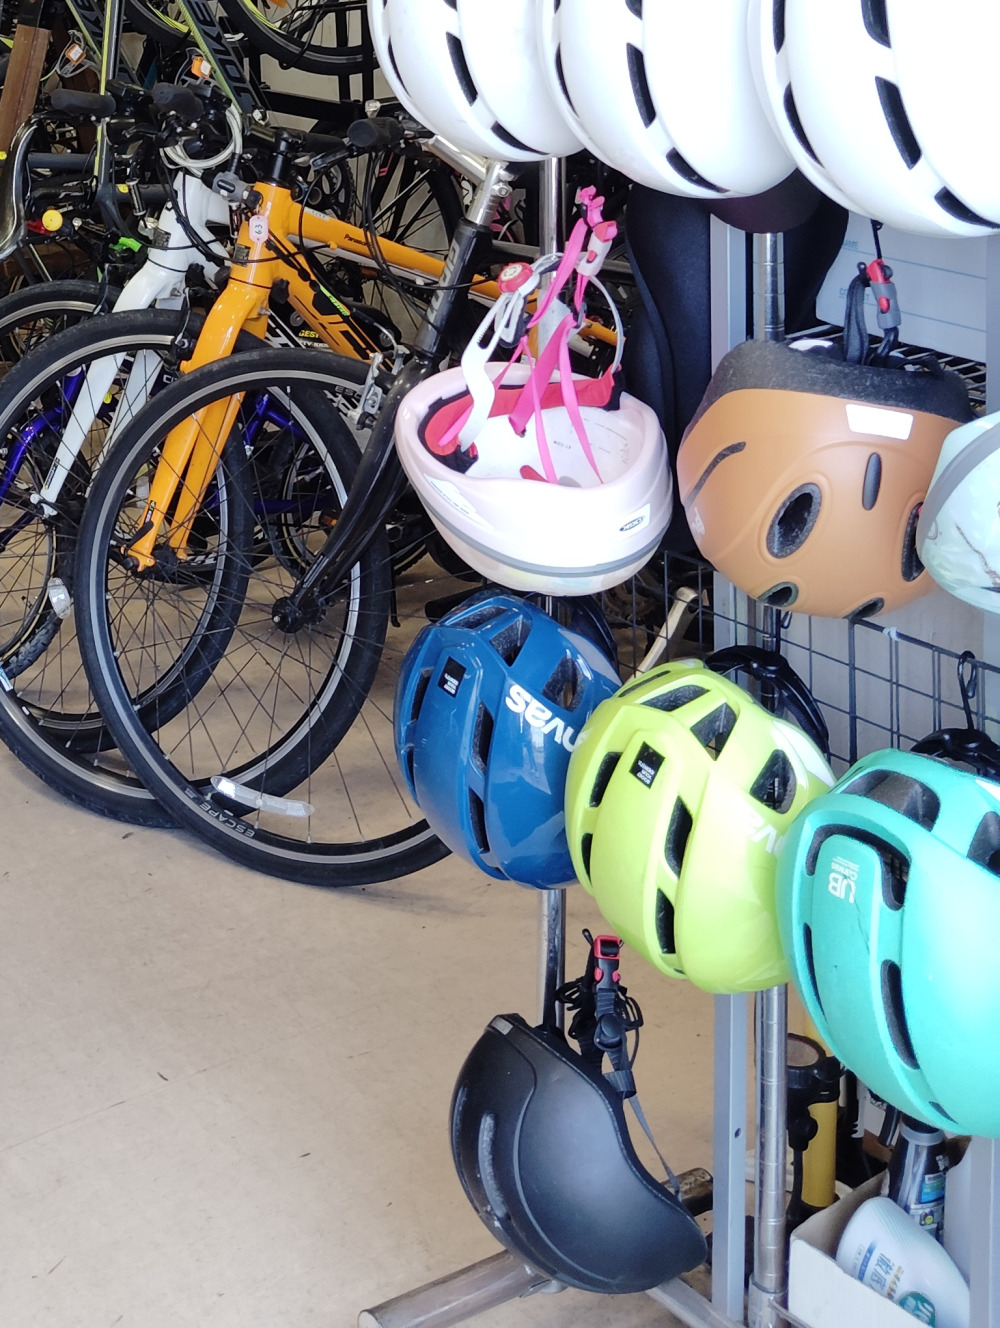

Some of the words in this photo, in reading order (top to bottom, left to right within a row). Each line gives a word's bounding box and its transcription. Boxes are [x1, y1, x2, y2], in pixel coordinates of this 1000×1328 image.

[254, 223, 263, 235] 63
[199, 801, 255, 838] ESCAPE
[828, 872, 856, 904] UB
